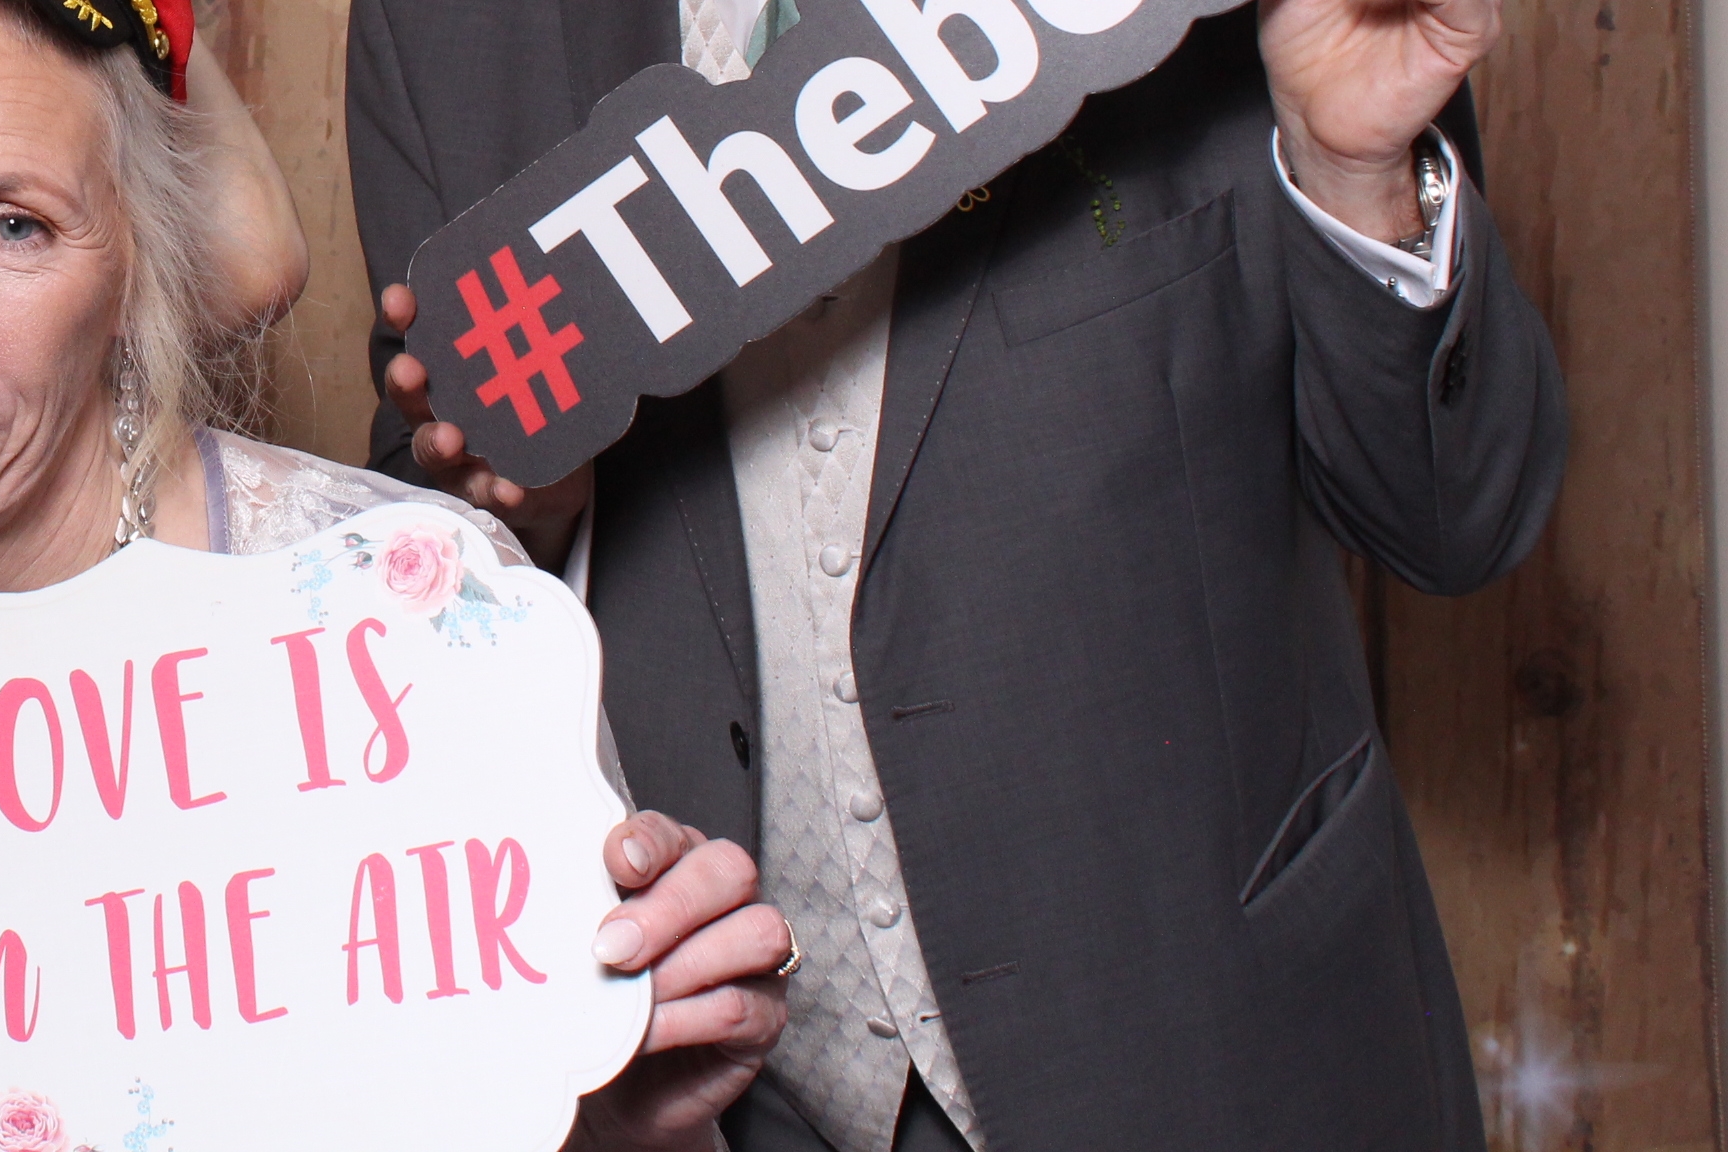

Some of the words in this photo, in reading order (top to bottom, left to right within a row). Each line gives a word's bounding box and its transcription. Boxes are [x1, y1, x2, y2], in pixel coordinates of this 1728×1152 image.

[270, 617, 414, 793] IS
[84, 867, 289, 1041] THE
[341, 837, 549, 1005] AIR
